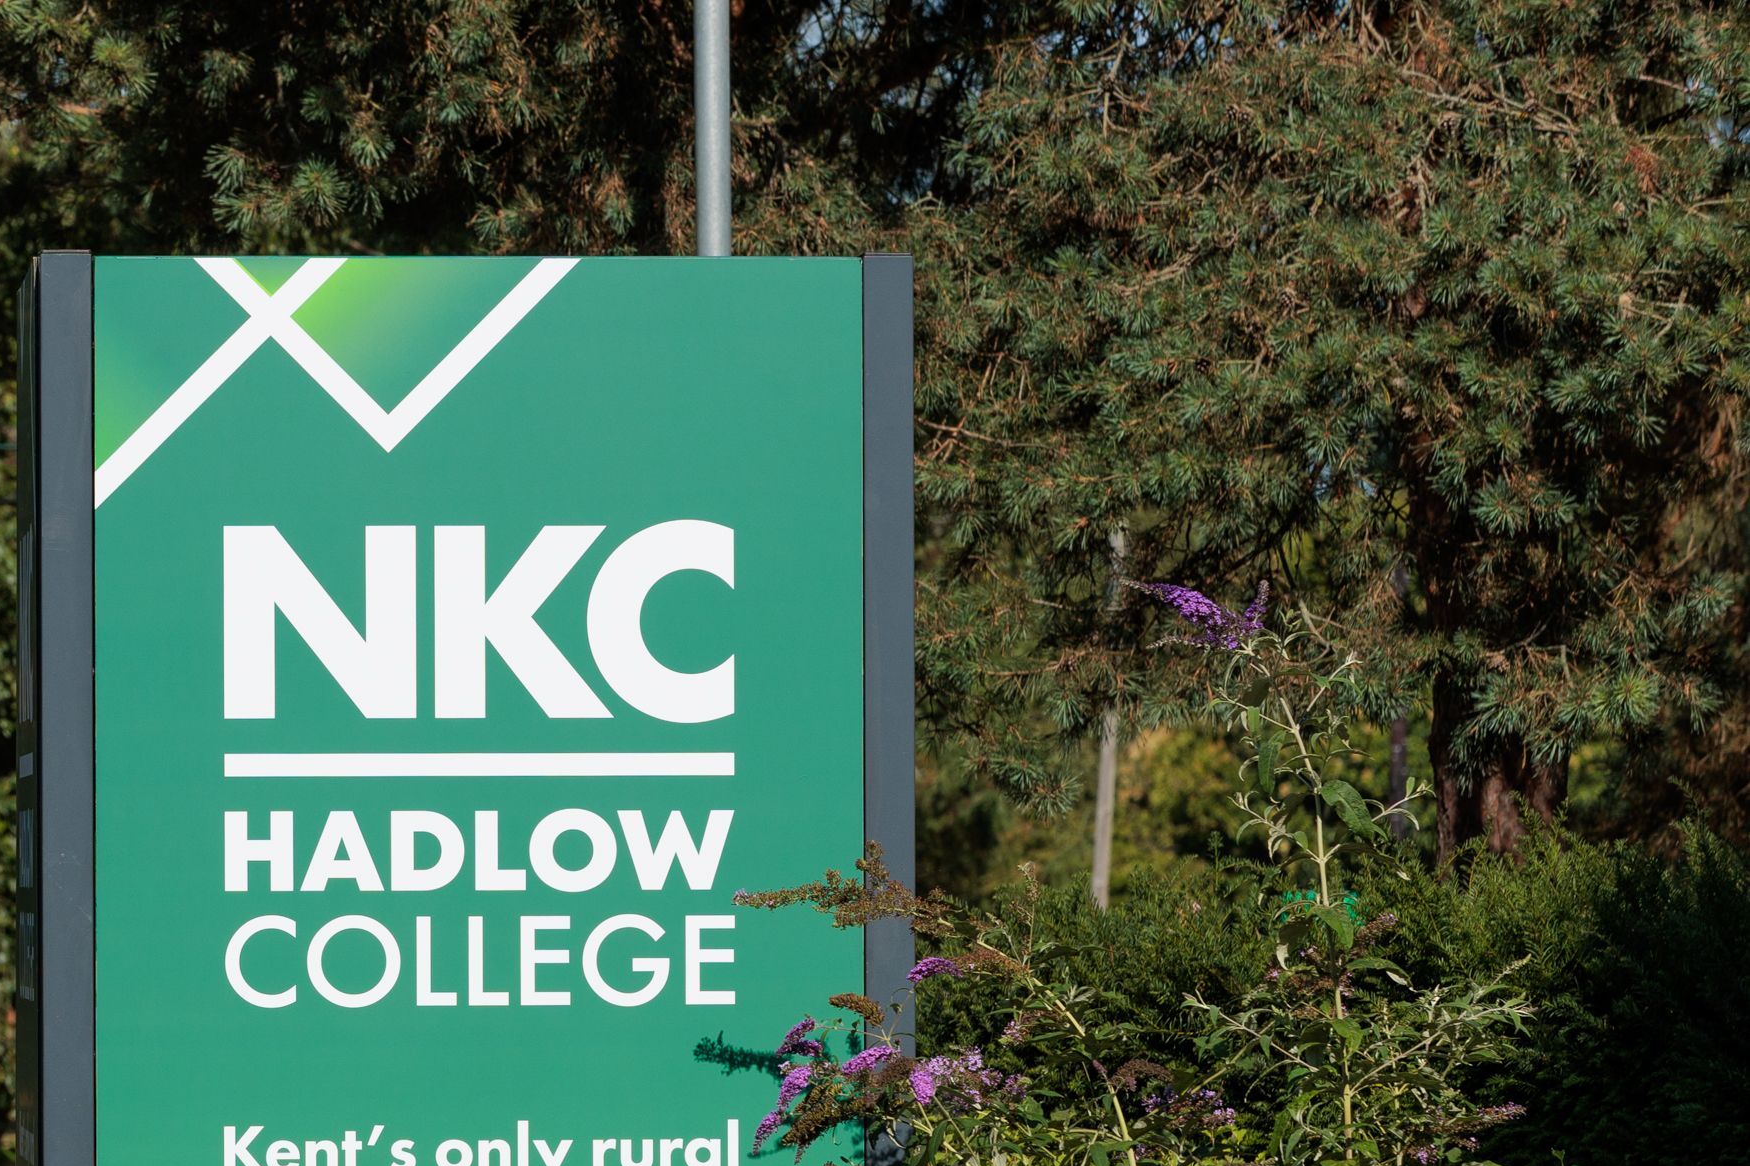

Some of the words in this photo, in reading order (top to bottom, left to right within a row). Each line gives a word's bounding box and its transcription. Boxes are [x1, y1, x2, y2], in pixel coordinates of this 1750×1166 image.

[223, 519, 735, 724] NKC
[224, 808, 735, 893] HADLOW
[224, 913, 737, 1010] COLLEGE
